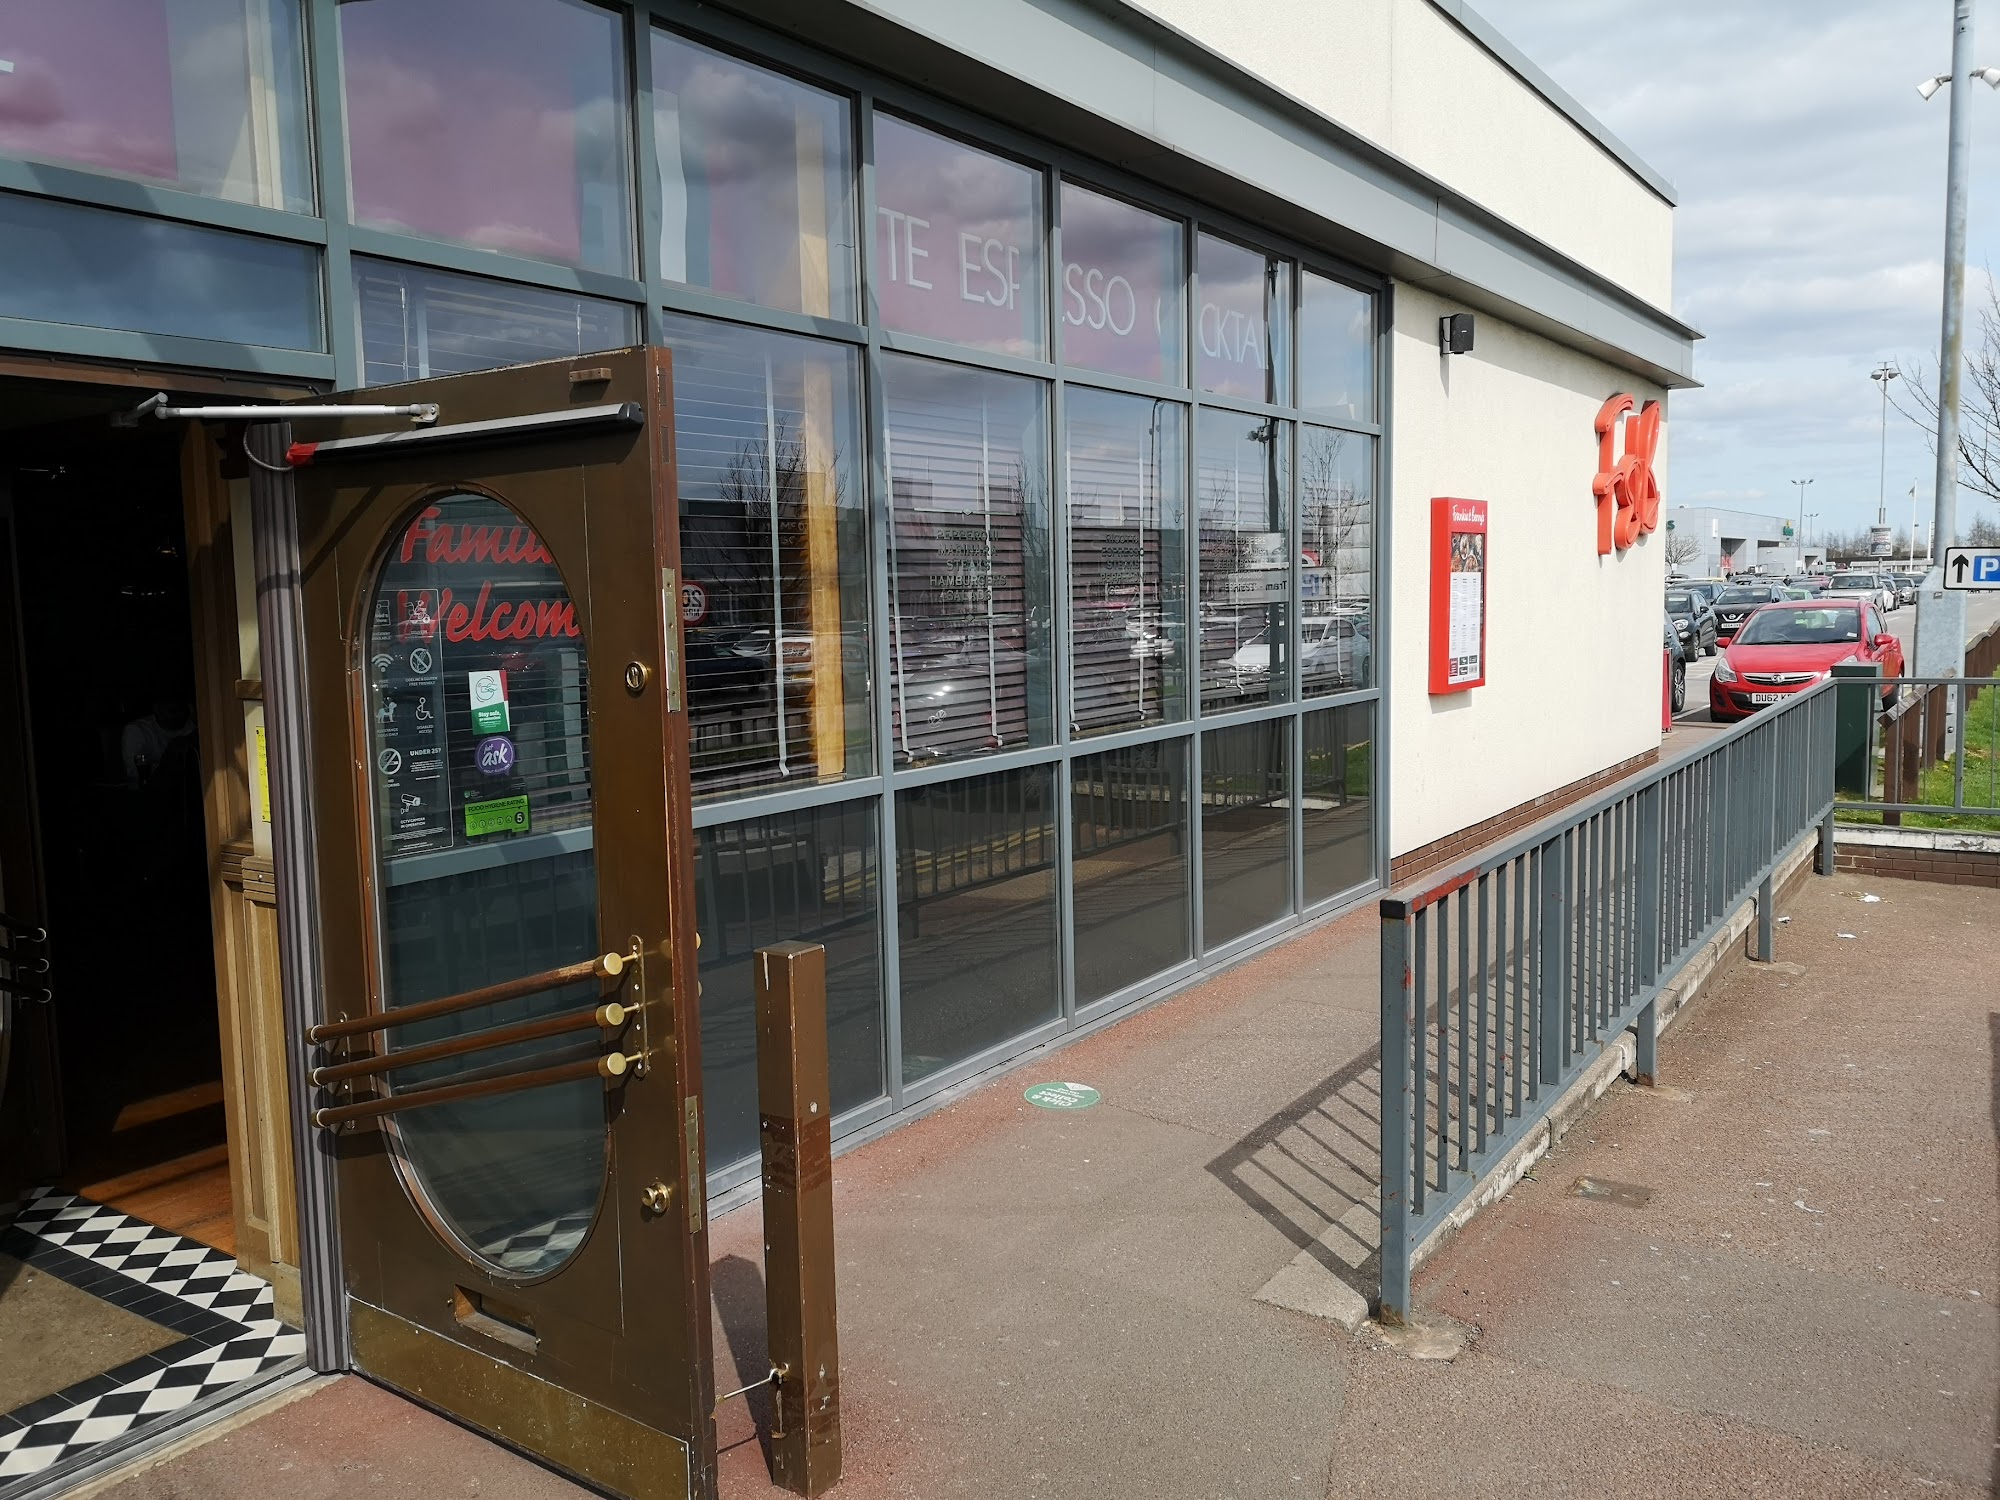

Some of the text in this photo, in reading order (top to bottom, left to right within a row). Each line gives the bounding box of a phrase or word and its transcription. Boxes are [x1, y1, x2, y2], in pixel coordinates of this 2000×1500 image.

[1979, 558, 1999, 580] P
[929, 575, 1007, 587] HAMBURGERS
[1755, 694, 1779, 702] DU62
[410, 749, 431, 757] UNDER
[482, 743, 508, 767] ask
[468, 798, 525, 812] FOOD HYGIENE RATING
